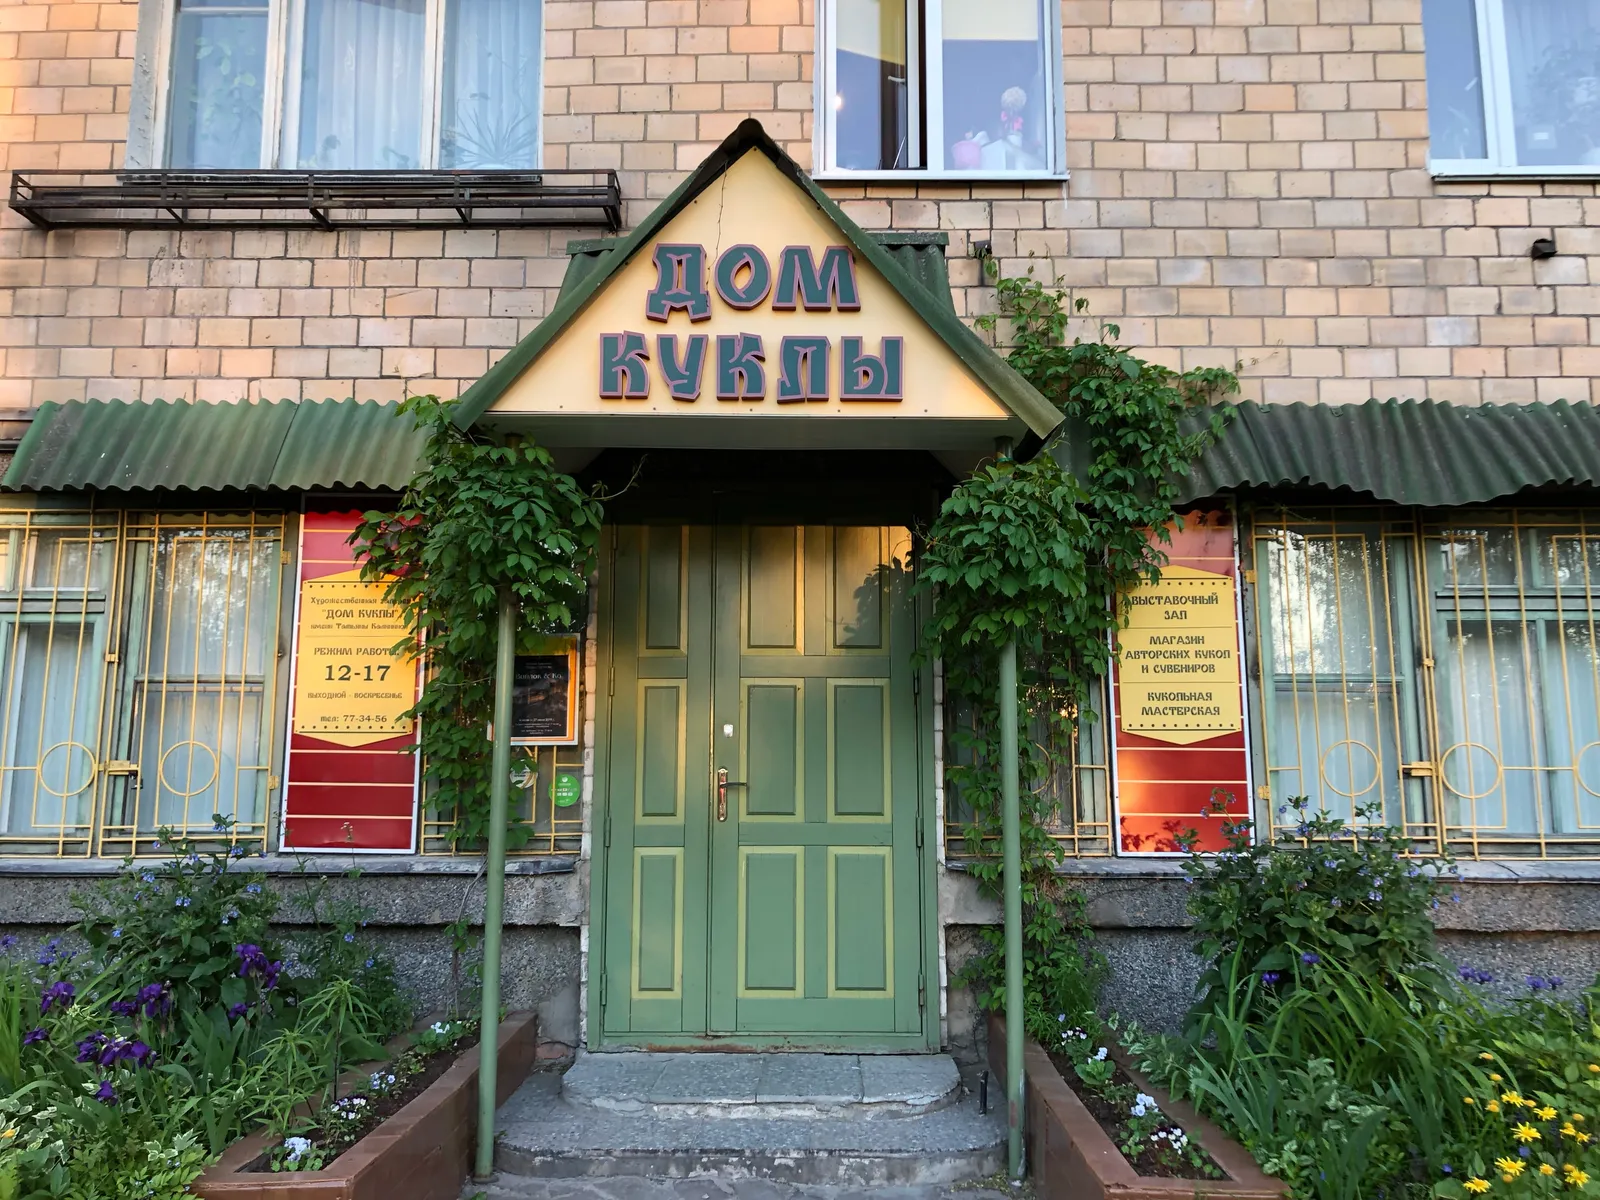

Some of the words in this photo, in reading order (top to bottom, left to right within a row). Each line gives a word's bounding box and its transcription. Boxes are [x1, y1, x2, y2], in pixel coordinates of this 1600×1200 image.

[646, 243, 862, 324] ДОМ
[599, 330, 906, 405] КУКЛЫ
[1131, 592, 1219, 606] ВЫСТАВОЧНЫЙ
[1164, 610, 1187, 620] ЗАЛ
[1149, 635, 1205, 645] МАГАЗИН
[314, 647, 352, 656] РЕЖИМ
[1125, 650, 1191, 660] АВТОРСКИХ
[1195, 649, 1231, 659] КУКОЛ
[324, 664, 391, 682] 12-17
[1141, 664, 1149, 674] И
[1153, 664, 1216, 674] СУВЕНИРОВ
[307, 691, 347, 700] ВЫХОДНОЙ
[354, 692, 403, 700] ВОСКРЕСЕНЬЕ
[1147, 691, 1213, 701] КУКОЛЬНАЯ
[1141, 706, 1220, 716] МАСТЕРСКАЯ
[320, 715, 339, 723] тел:
[343, 714, 388, 723] 77-34-56
